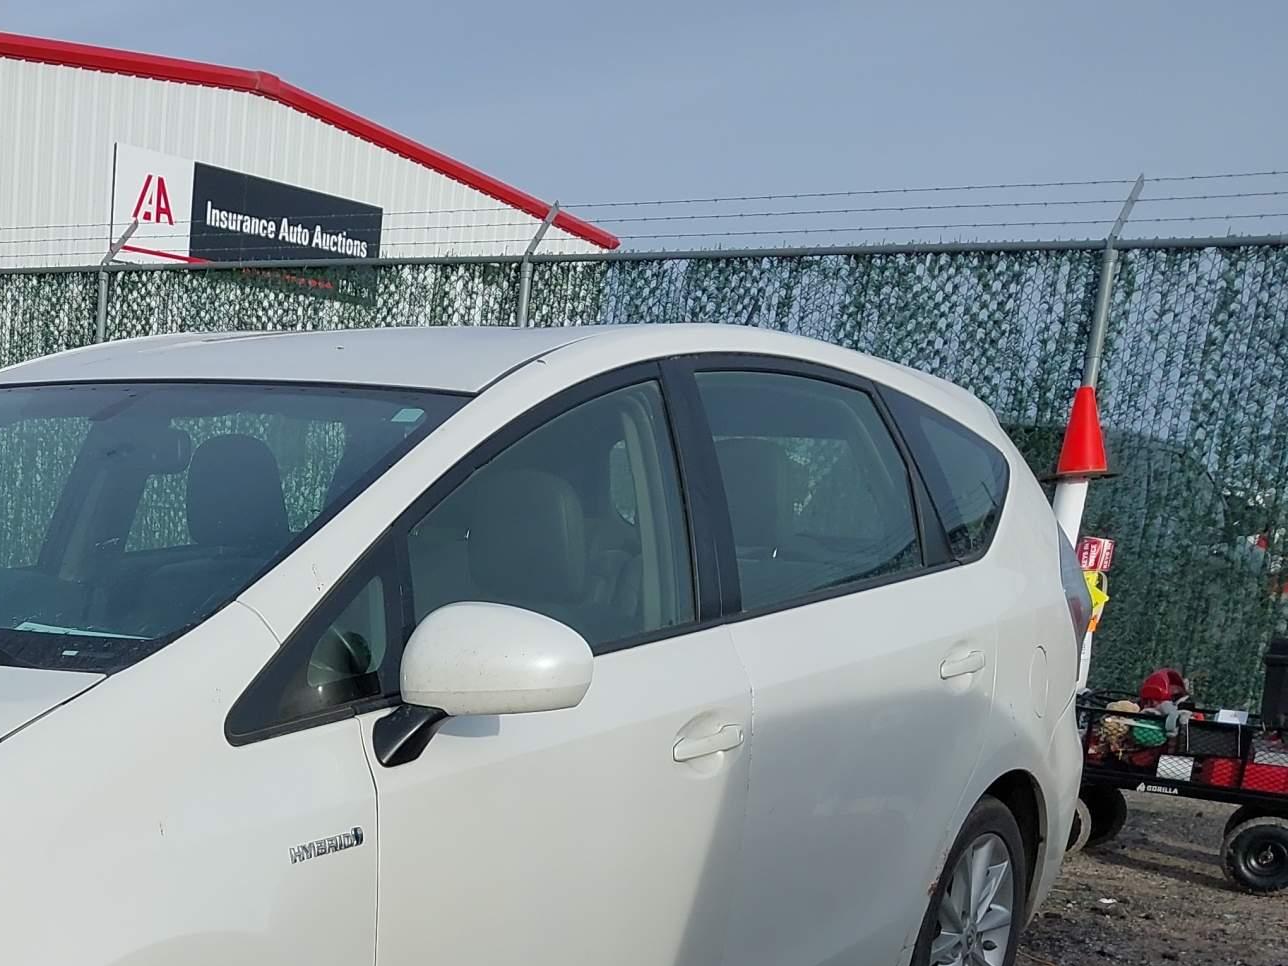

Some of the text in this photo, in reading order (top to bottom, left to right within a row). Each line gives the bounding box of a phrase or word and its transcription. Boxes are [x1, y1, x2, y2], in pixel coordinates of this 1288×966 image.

[206, 200, 368, 258] Insurance Auto Auctions
[1146, 785, 1179, 795] GORILLA
[289, 832, 353, 865] HYBRID
